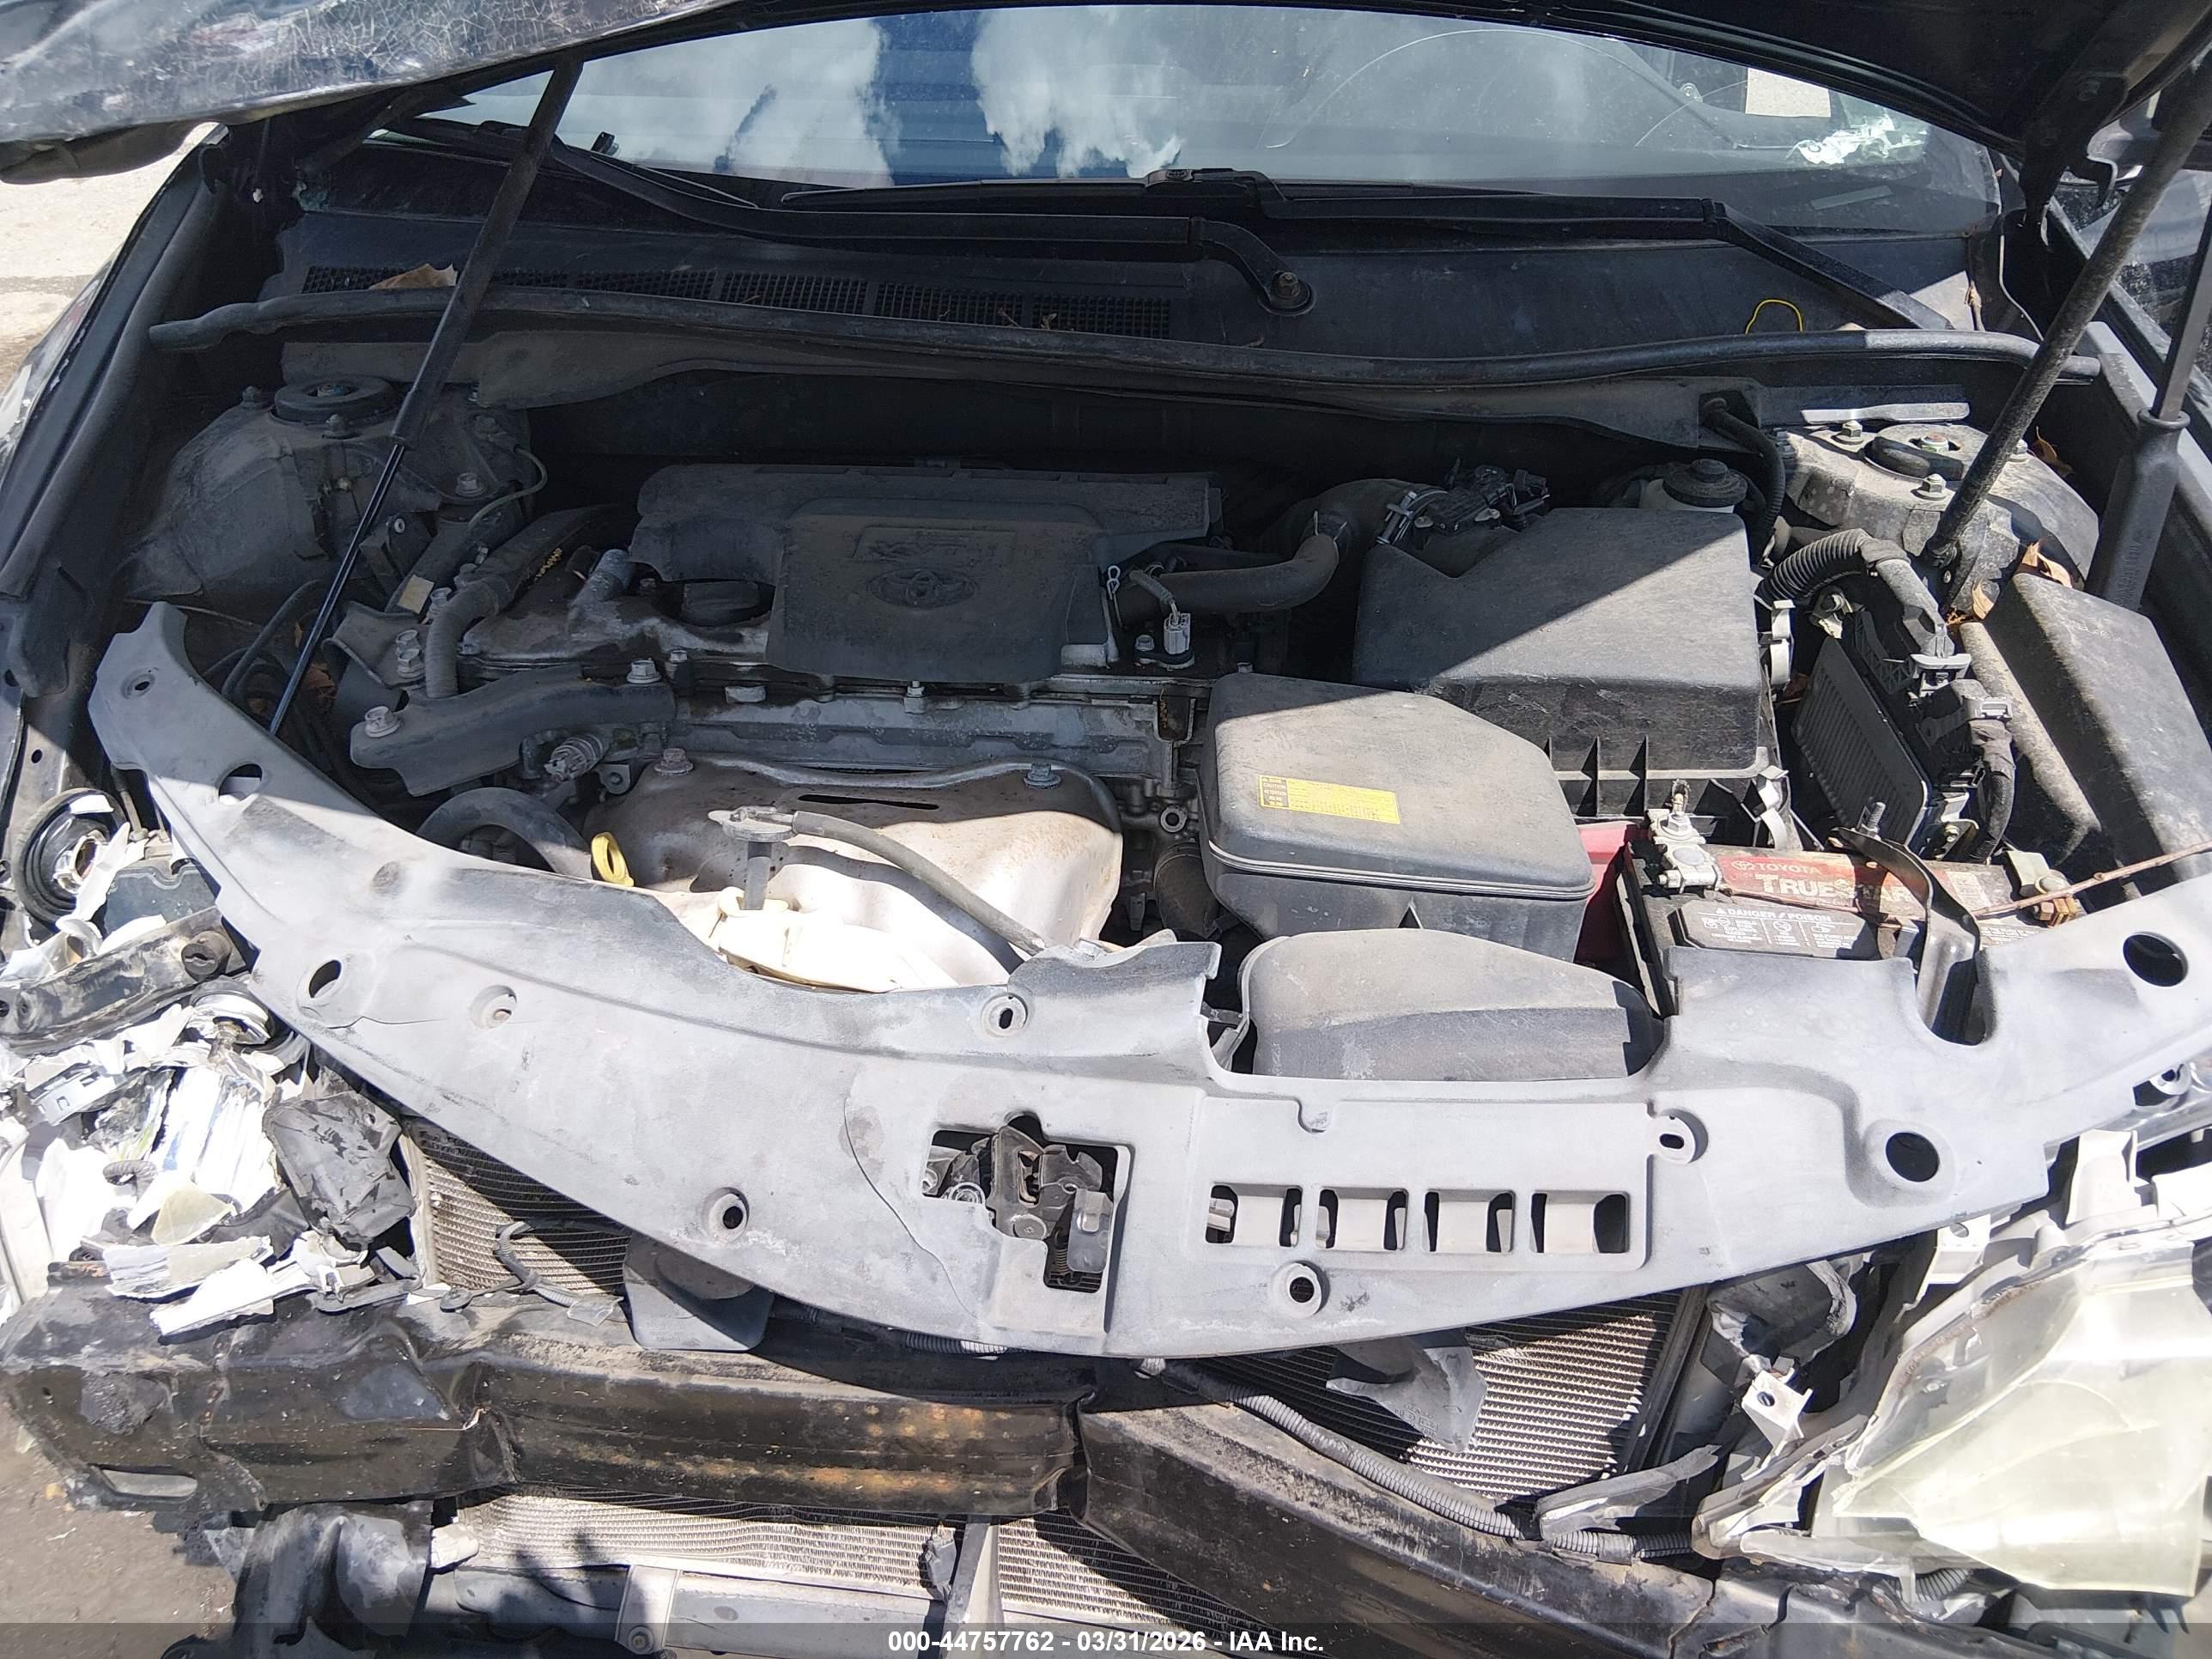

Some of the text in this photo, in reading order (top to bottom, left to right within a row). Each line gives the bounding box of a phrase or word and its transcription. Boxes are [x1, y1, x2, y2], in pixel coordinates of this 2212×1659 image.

[1755, 862, 1823, 875] TOYOTA
[1727, 908, 1777, 919] DANGER
[1787, 913, 1832, 923] POISON
